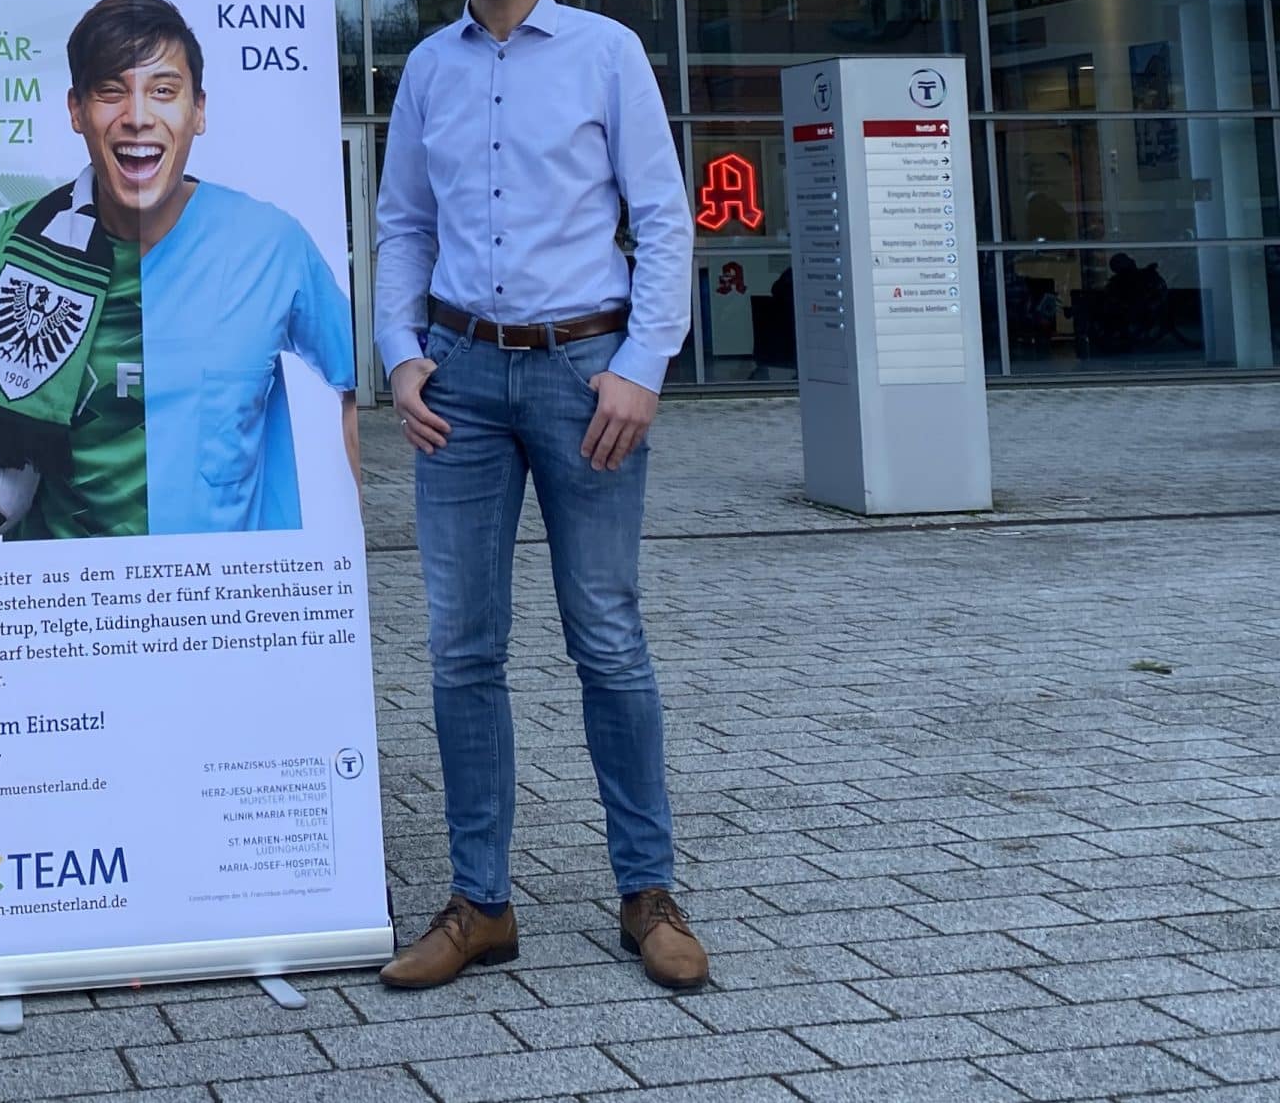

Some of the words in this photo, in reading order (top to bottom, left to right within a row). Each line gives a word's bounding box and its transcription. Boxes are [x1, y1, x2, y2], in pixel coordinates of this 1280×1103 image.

[217, 4, 305, 29] KANN
[242, 46, 308, 71] DAS.
[5, 77, 41, 102] IM
[4, 371, 30, 389] 1906
[42, 571, 70, 584] aus
[80, 567, 115, 582] dem
[125, 562, 212, 580] FLEXTEAM
[221, 559, 324, 576] unterstützen
[333, 556, 352, 571] ab
[91, 592, 142, 607] Teams
[146, 589, 171, 603] der
[176, 586, 210, 602] fünf
[215, 583, 333, 601] Krankenhäuser
[337, 581, 353, 595] in
[41, 618, 92, 638] Telgte,
[95, 612, 207, 633] Lüdinghausen
[211, 610, 241, 625] und
[245, 609, 300, 624] Greven
[303, 606, 355, 622] immer
[26, 643, 89, 660] besteht.
[92, 640, 138, 656] Somit
[142, 638, 178, 653] wird
[182, 637, 208, 651] der
[212, 633, 297, 651] Dienstplan
[301, 631, 324, 646] für
[328, 629, 355, 644] alle
[26, 711, 105, 734] Einsatz!
[223, 810, 254, 822] KLINIK
[256, 809, 285, 820] MARIA
[288, 807, 328, 818] FRIEDEN
